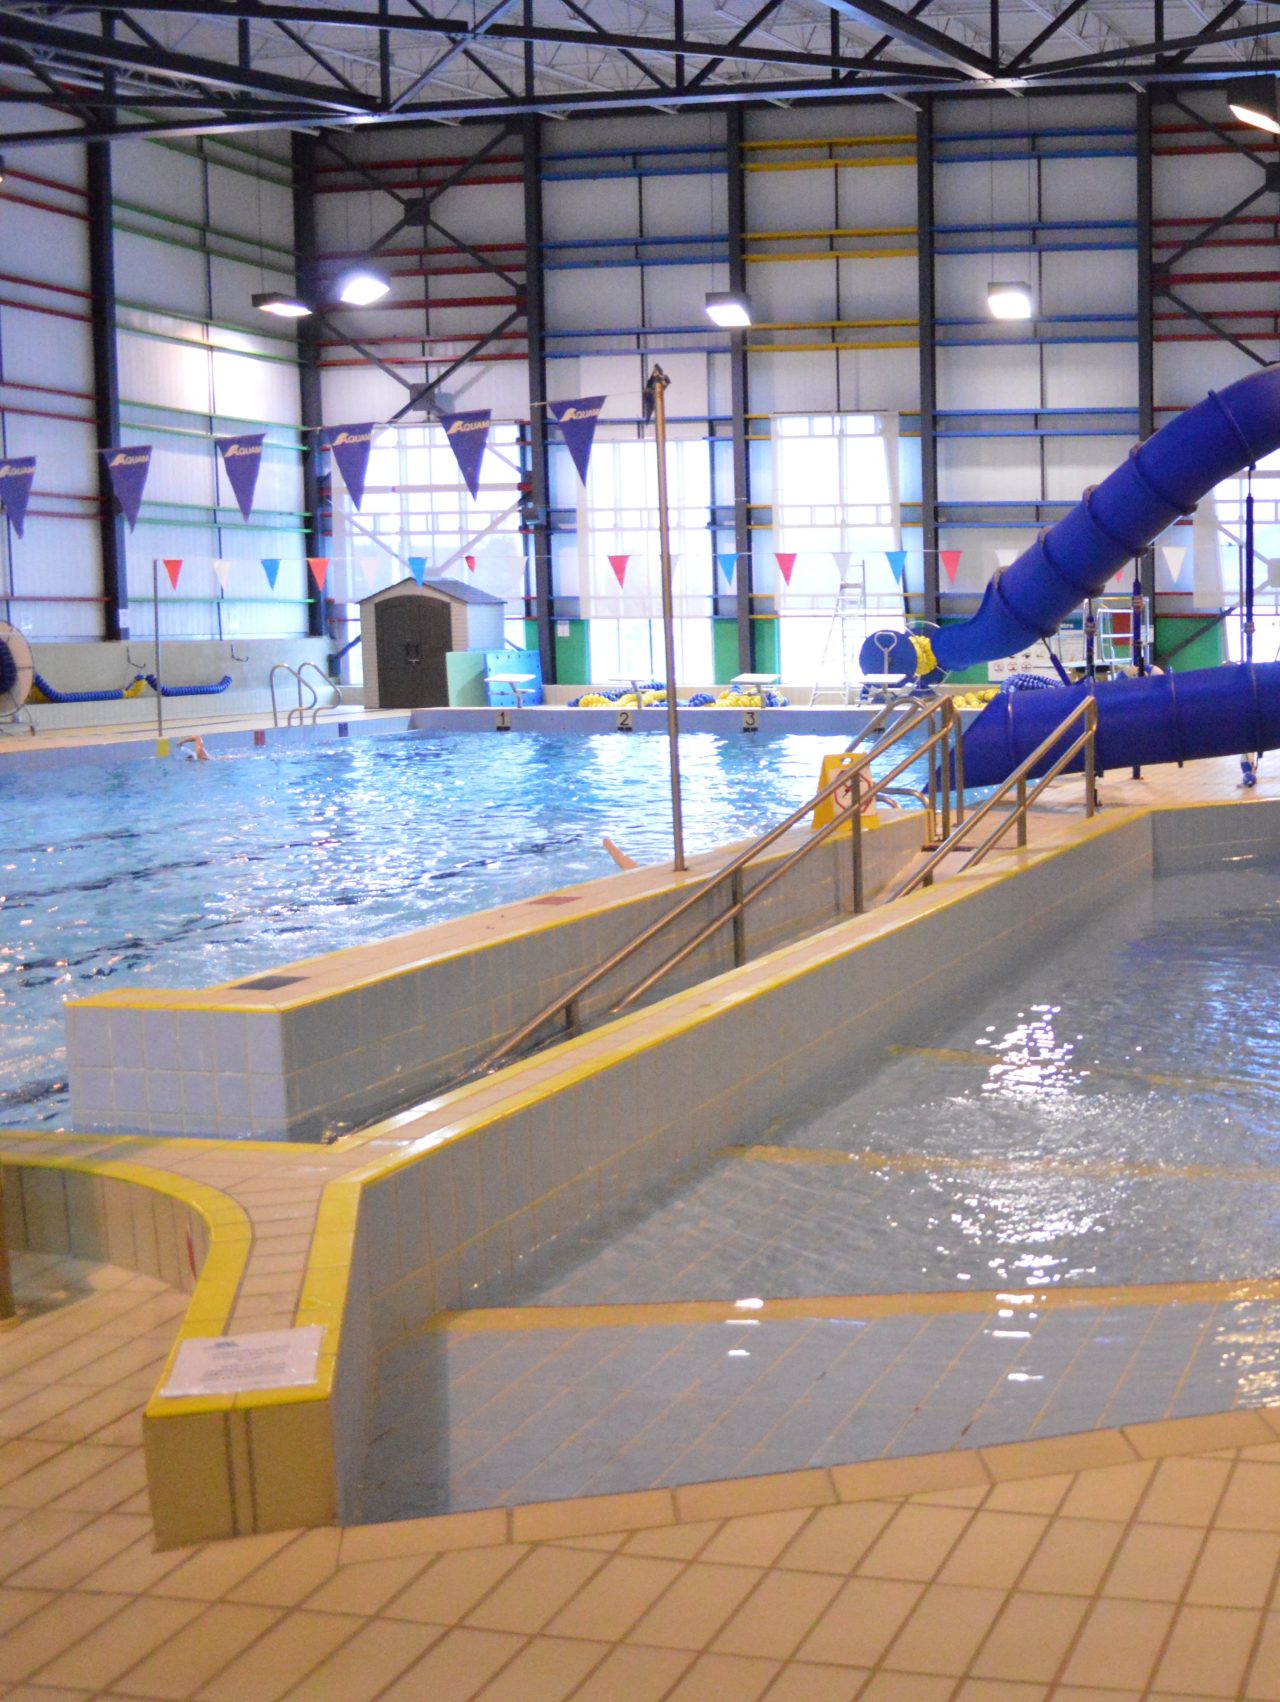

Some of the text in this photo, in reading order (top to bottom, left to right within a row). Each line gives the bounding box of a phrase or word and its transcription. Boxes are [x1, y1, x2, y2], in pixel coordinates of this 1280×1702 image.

[447, 420, 491, 434] AQUAM
[224, 443, 263, 458] AQUAM
[110, 453, 150, 467] AQUAM
[499, 712, 506, 726] 1
[619, 712, 630, 726] 2
[745, 712, 757, 726] 3
